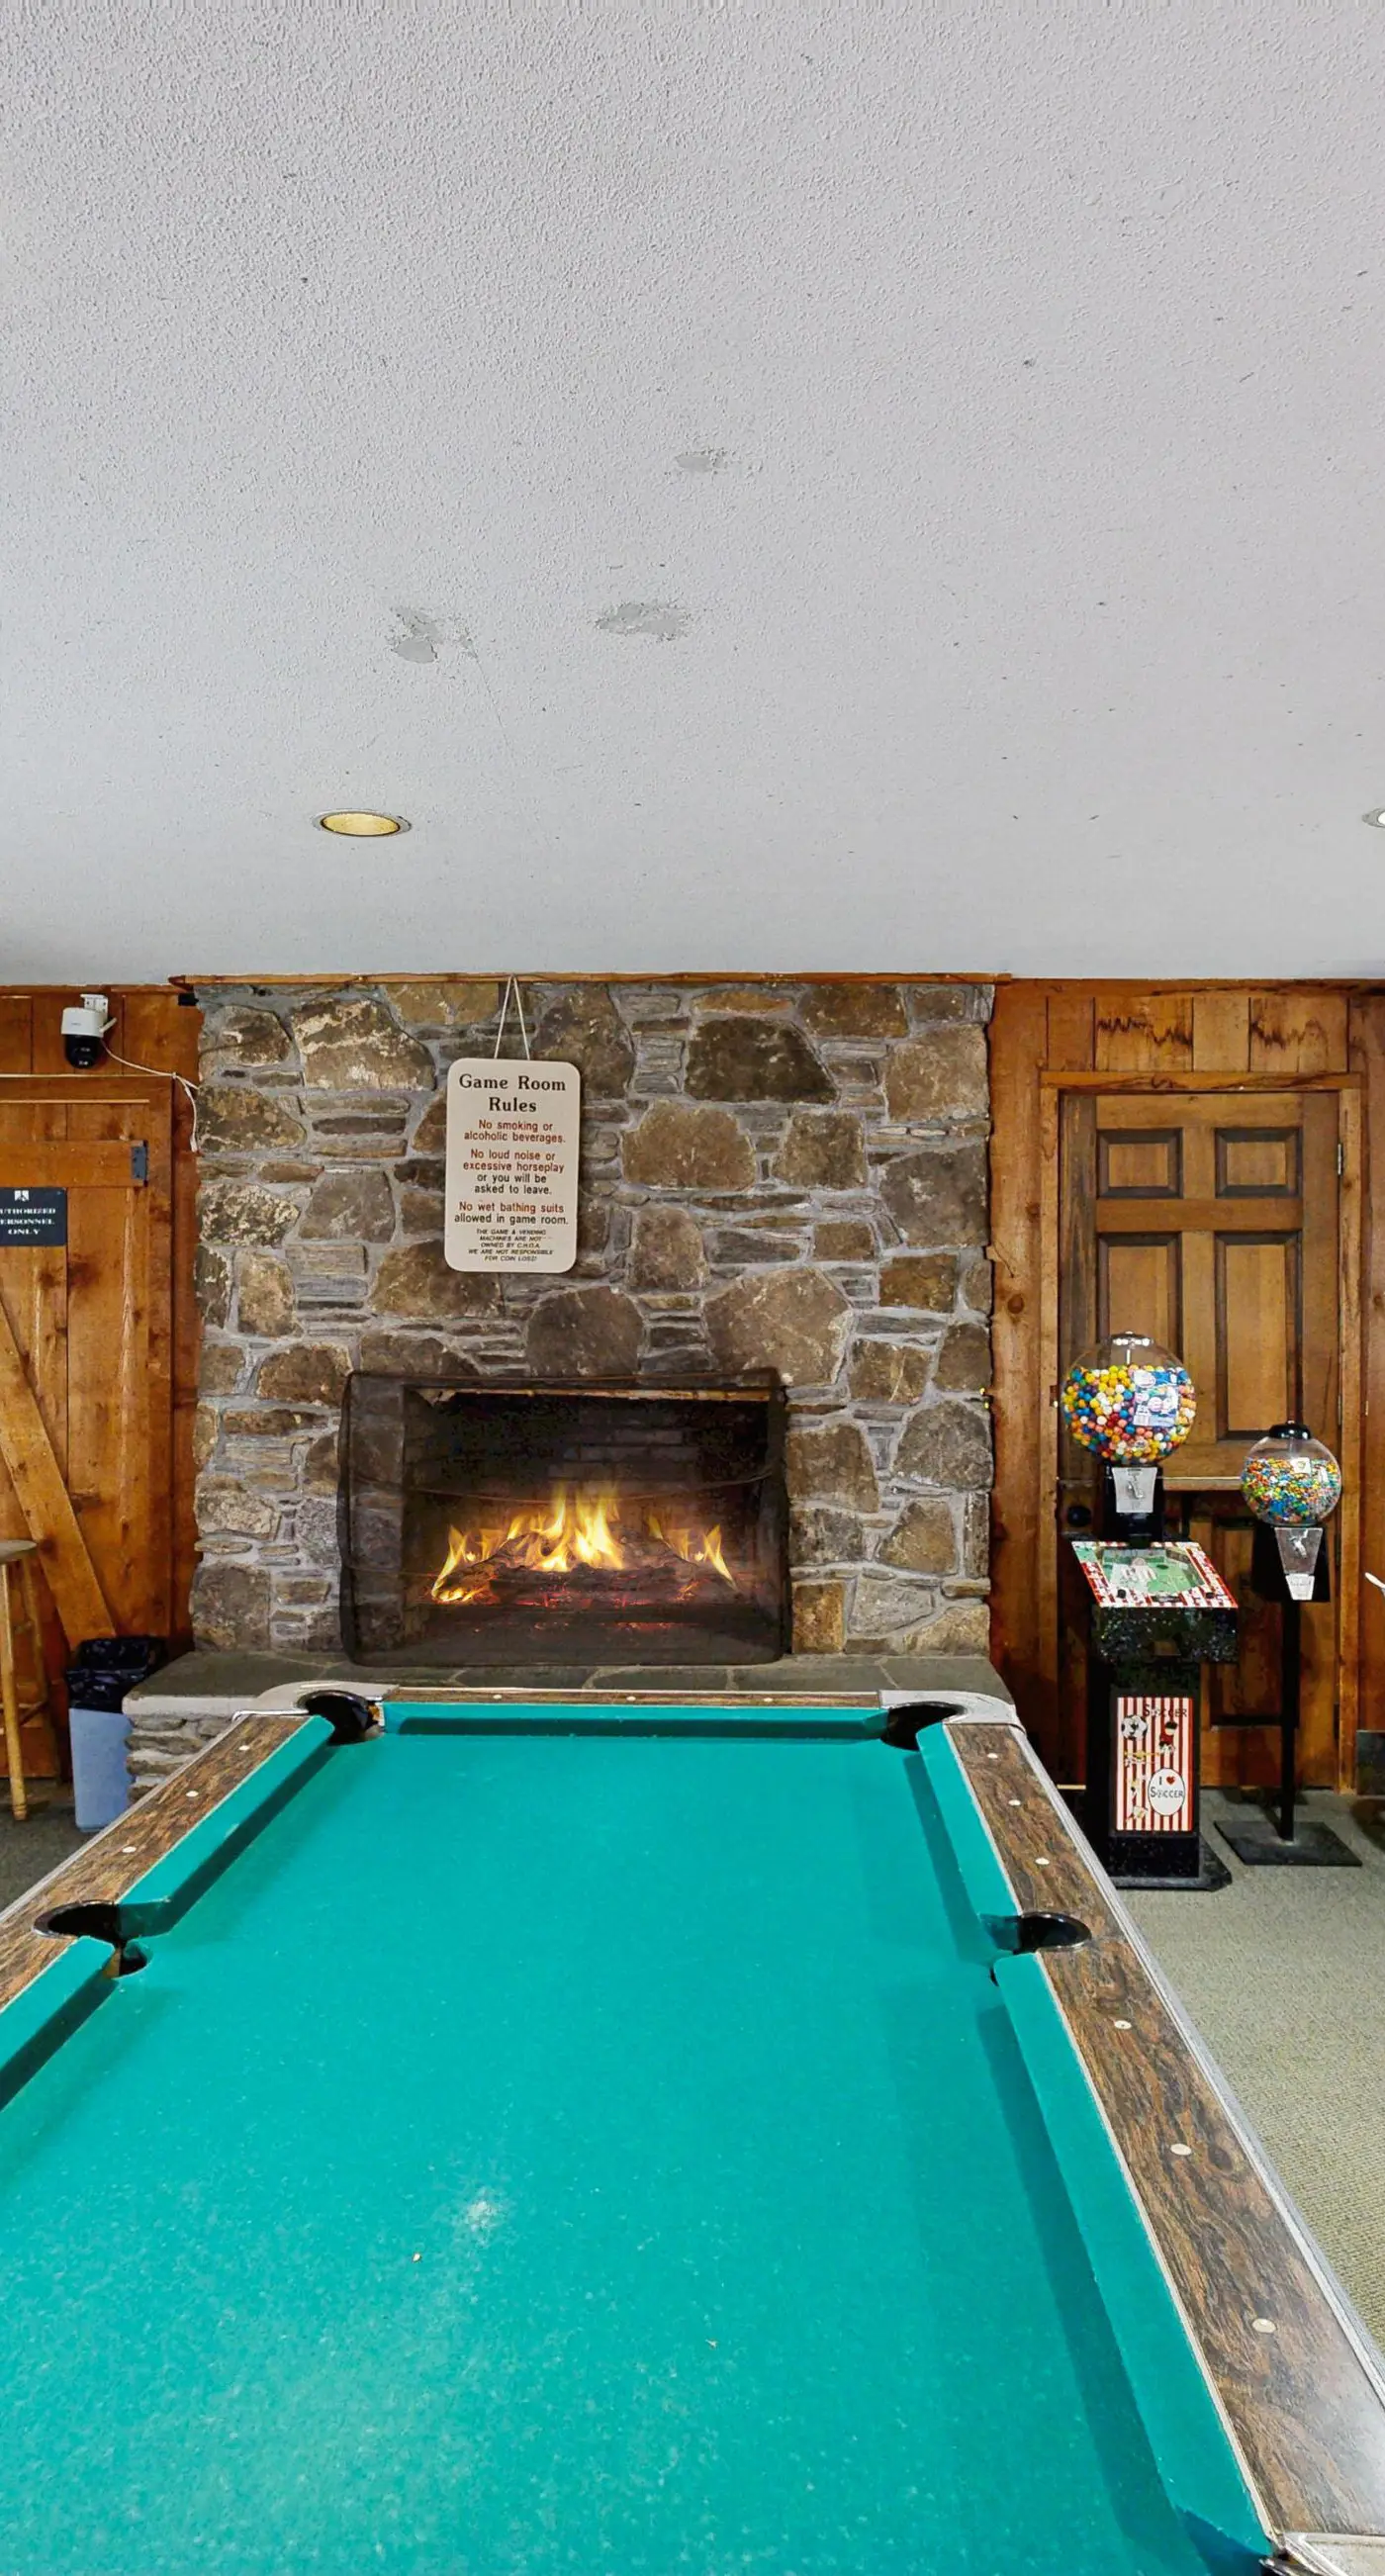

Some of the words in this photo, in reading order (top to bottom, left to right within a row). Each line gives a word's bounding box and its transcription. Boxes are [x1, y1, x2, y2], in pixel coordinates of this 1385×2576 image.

[459, 1073, 508, 1089] Game
[518, 1075, 566, 1091] Room
[489, 1097, 537, 1112] Rules
[479, 1120, 493, 1130] No
[498, 1122, 538, 1133] smoking
[464, 1131, 508, 1141] alcoholic
[512, 1133, 566, 1145] beverages.
[471, 1149, 484, 1158] No
[489, 1150, 509, 1159] loud
[514, 1150, 540, 1160] noise
[546, 1152, 555, 1161] or
[463, 1161, 511, 1171] excessive
[516, 1162, 565, 1173] horseplay
[492, 1174, 509, 1184] you
[514, 1174, 530, 1183] will
[534, 1174, 547, 1184] be
[475, 1184, 505, 1194] asked
[509, 1185, 519, 1194] to
[523, 1185, 552, 1195] leave.
[459, 1201, 473, 1212] No
[478, 1203, 495, 1212] wet
[500, 1202, 536, 1215] bathing
[540, 1205, 564, 1214] suits
[454, 1213, 492, 1223] allowed
[497, 1214, 506, 1224] in
[509, 1216, 536, 1226] game
[540, 1216, 569, 1225] room.
